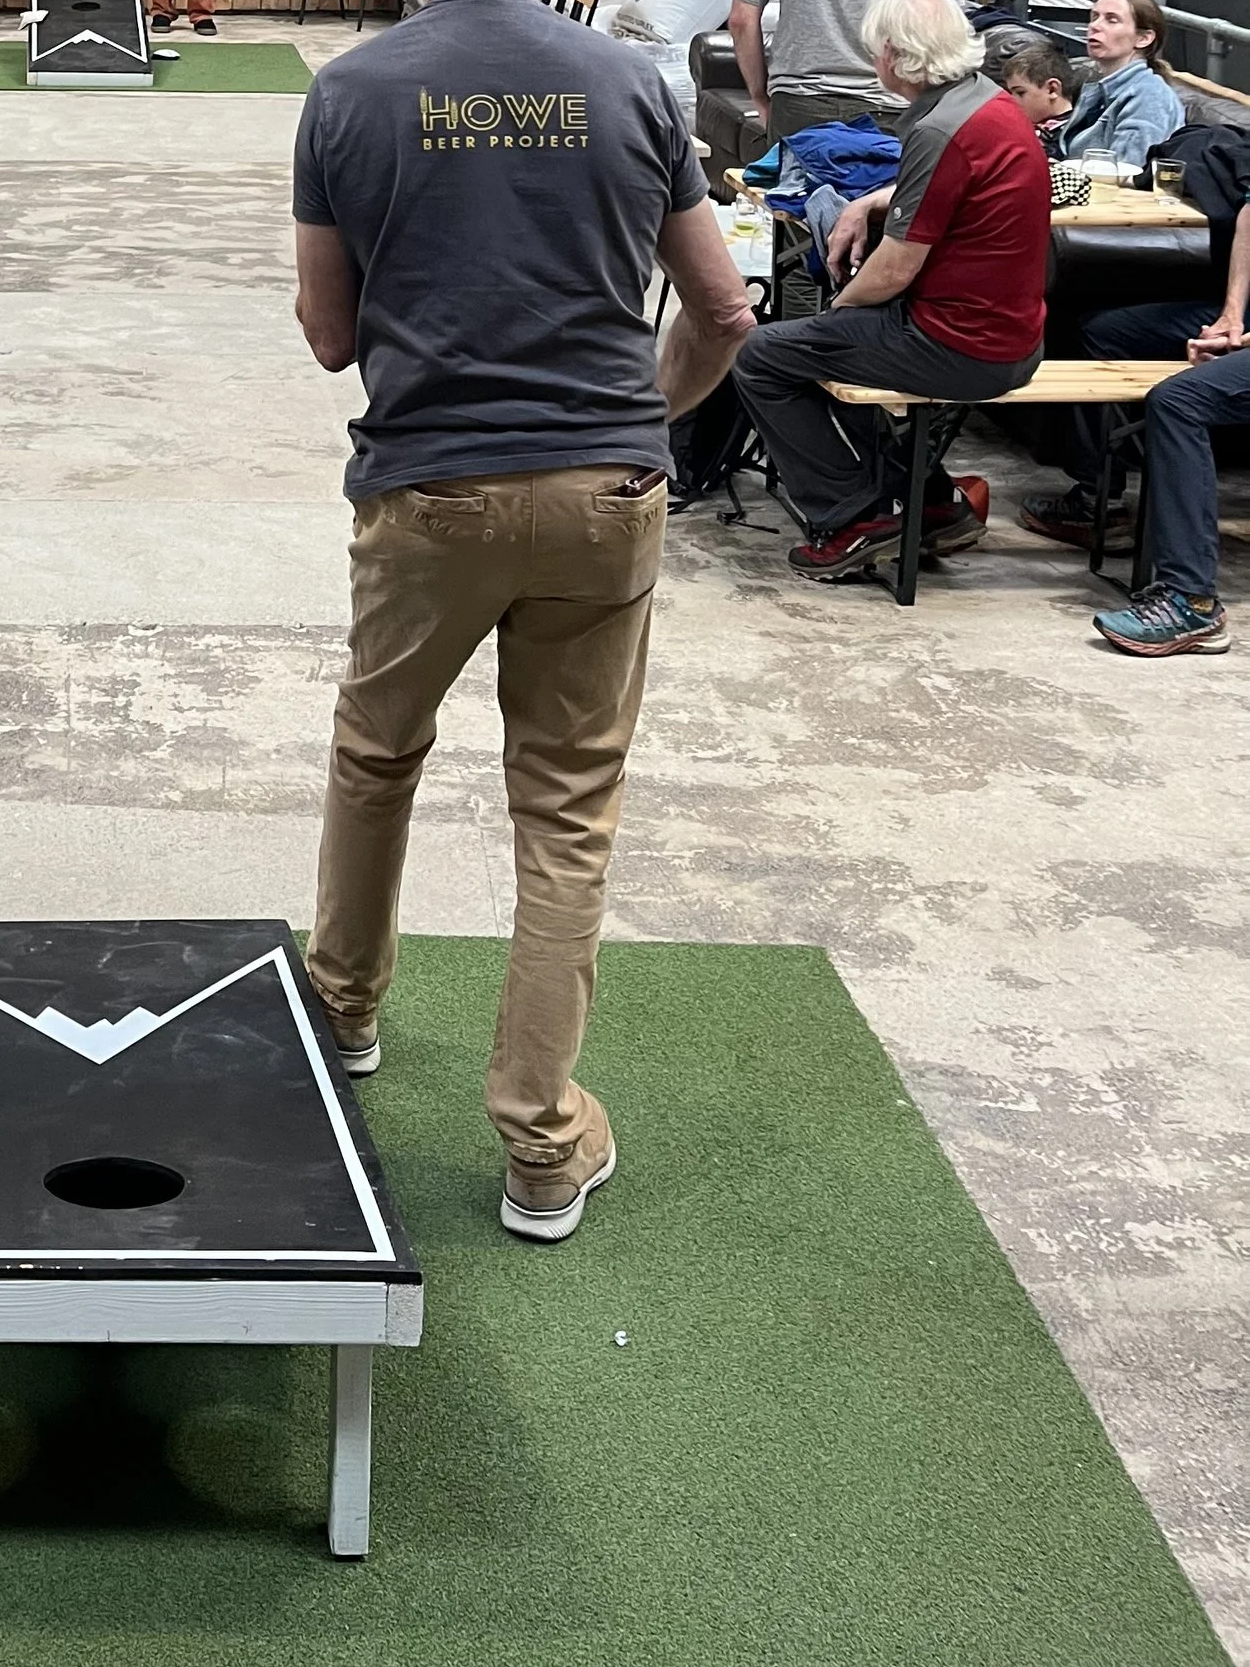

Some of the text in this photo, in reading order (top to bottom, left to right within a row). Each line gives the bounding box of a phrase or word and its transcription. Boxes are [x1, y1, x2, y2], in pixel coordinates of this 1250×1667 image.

[419, 86, 588, 132] HOWE
[423, 135, 589, 151] BEER PROJECT
